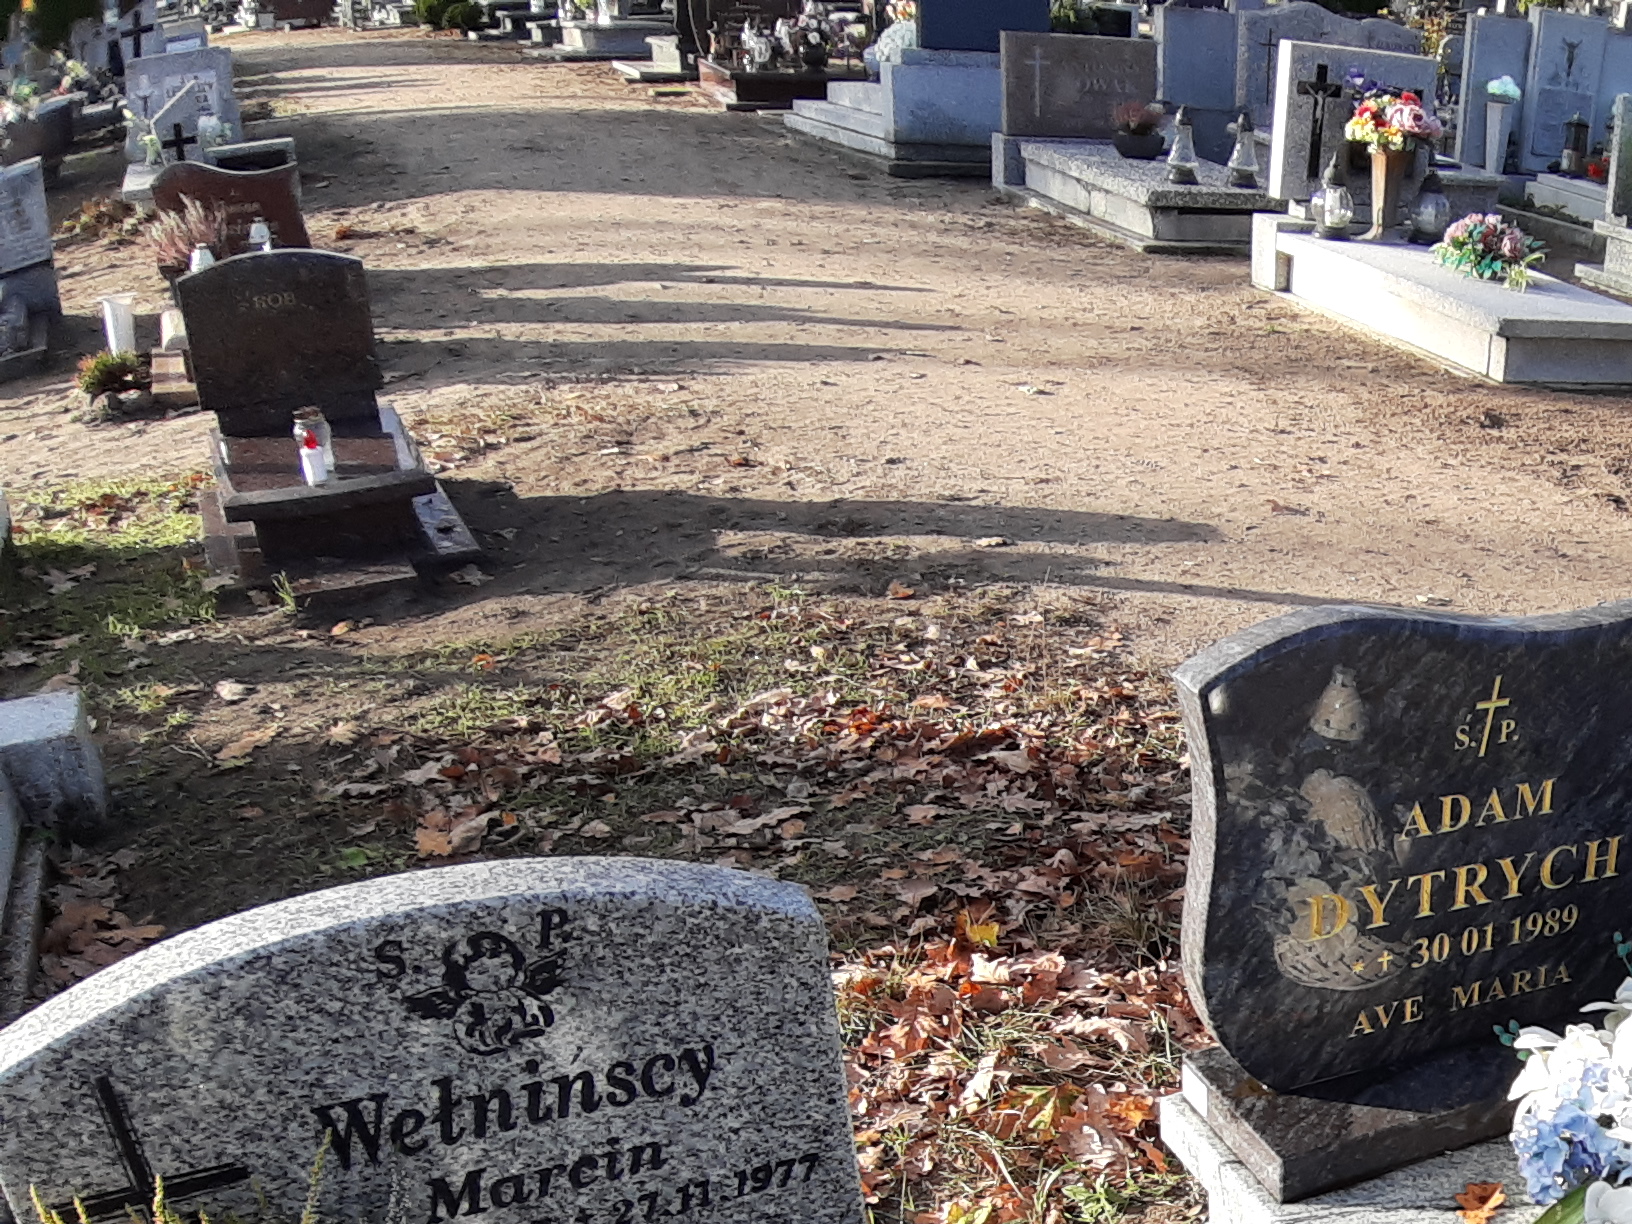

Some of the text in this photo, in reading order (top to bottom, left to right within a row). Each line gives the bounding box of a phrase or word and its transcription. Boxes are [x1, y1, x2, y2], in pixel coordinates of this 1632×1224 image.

[1398, 777, 1557, 842] ADAM
[1306, 835, 1625, 942] DYTRYCH
[1411, 904, 1580, 970] 30 01 1989
[1348, 961, 1573, 1039] AVE MARIA
